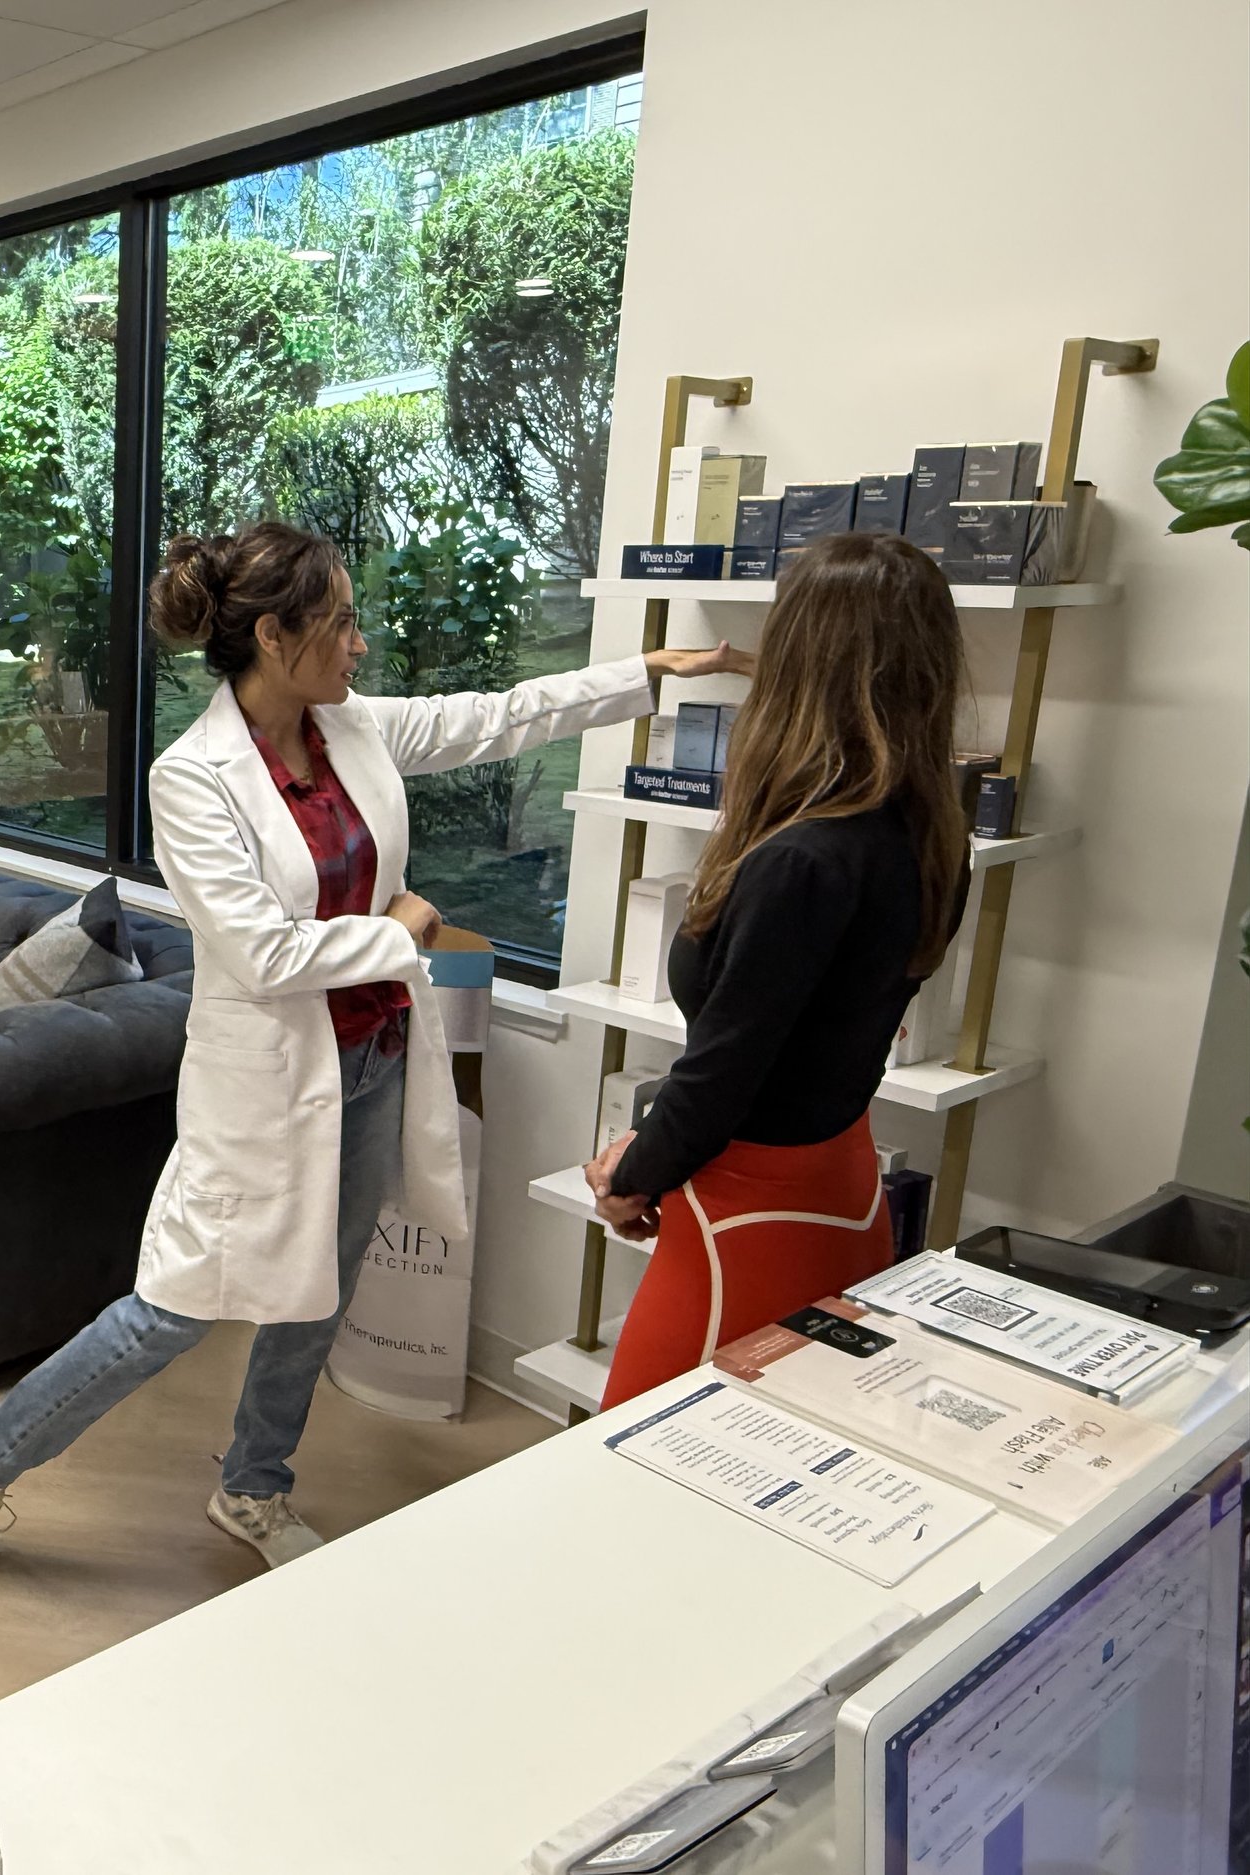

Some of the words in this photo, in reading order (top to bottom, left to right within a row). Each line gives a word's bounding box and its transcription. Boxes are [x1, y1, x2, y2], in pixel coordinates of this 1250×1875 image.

[640, 551, 663, 563] Where
[665, 552, 673, 563] to
[674, 550, 694, 564] Start
[634, 772, 666, 789] Targeted
[668, 776, 711, 794] Treatments
[1114, 1330, 1147, 1346] PAY
[1091, 1342, 1128, 1360] OVER
[1067, 1358, 1104, 1377] TIME
[1001, 1430, 1046, 1455] Flash
[1018, 1453, 1054, 1474] with
